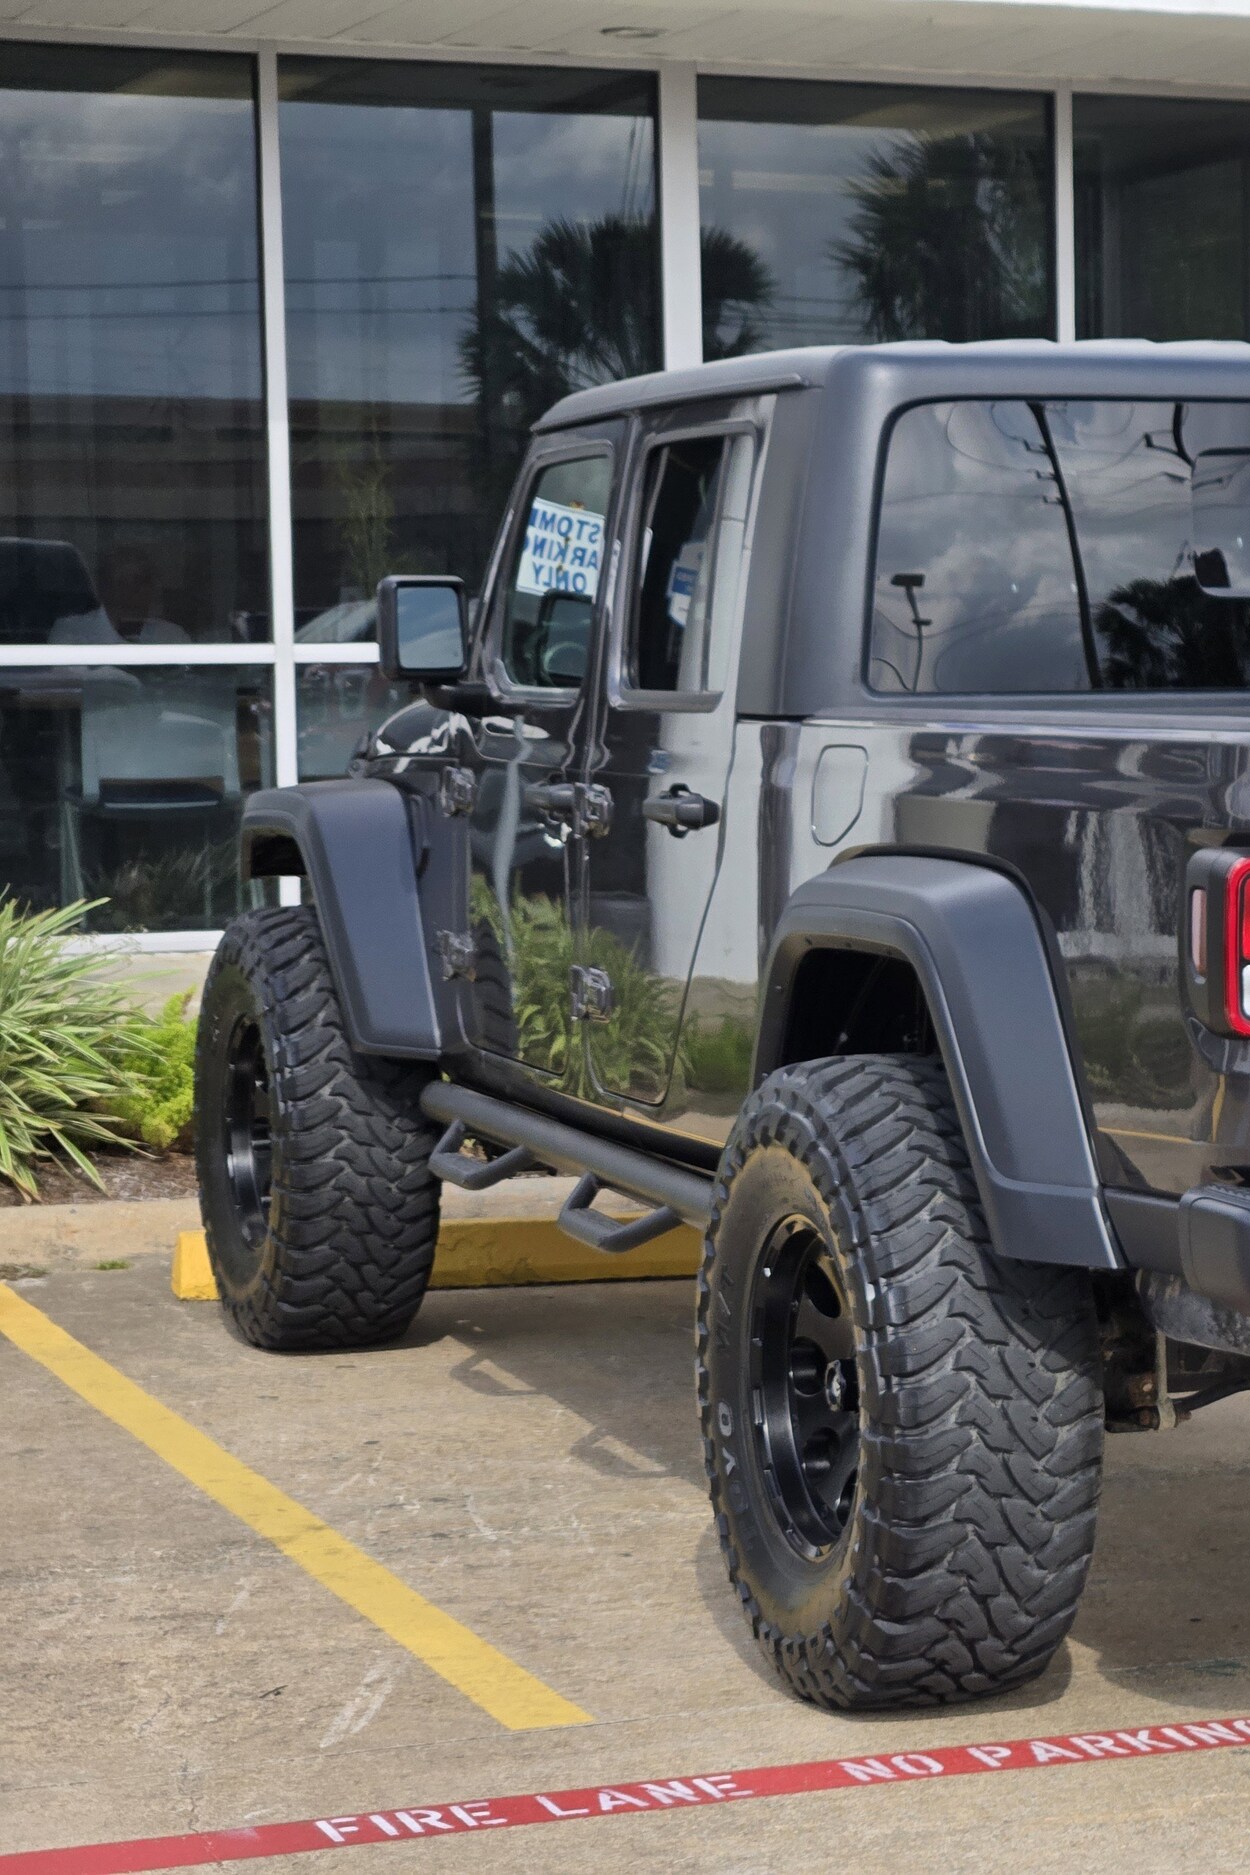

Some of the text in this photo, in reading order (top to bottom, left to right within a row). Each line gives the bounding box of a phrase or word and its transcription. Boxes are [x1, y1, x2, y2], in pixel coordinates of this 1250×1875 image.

[839, 1754, 944, 1782] NO
[315, 1775, 753, 1842] FIRE LANE
